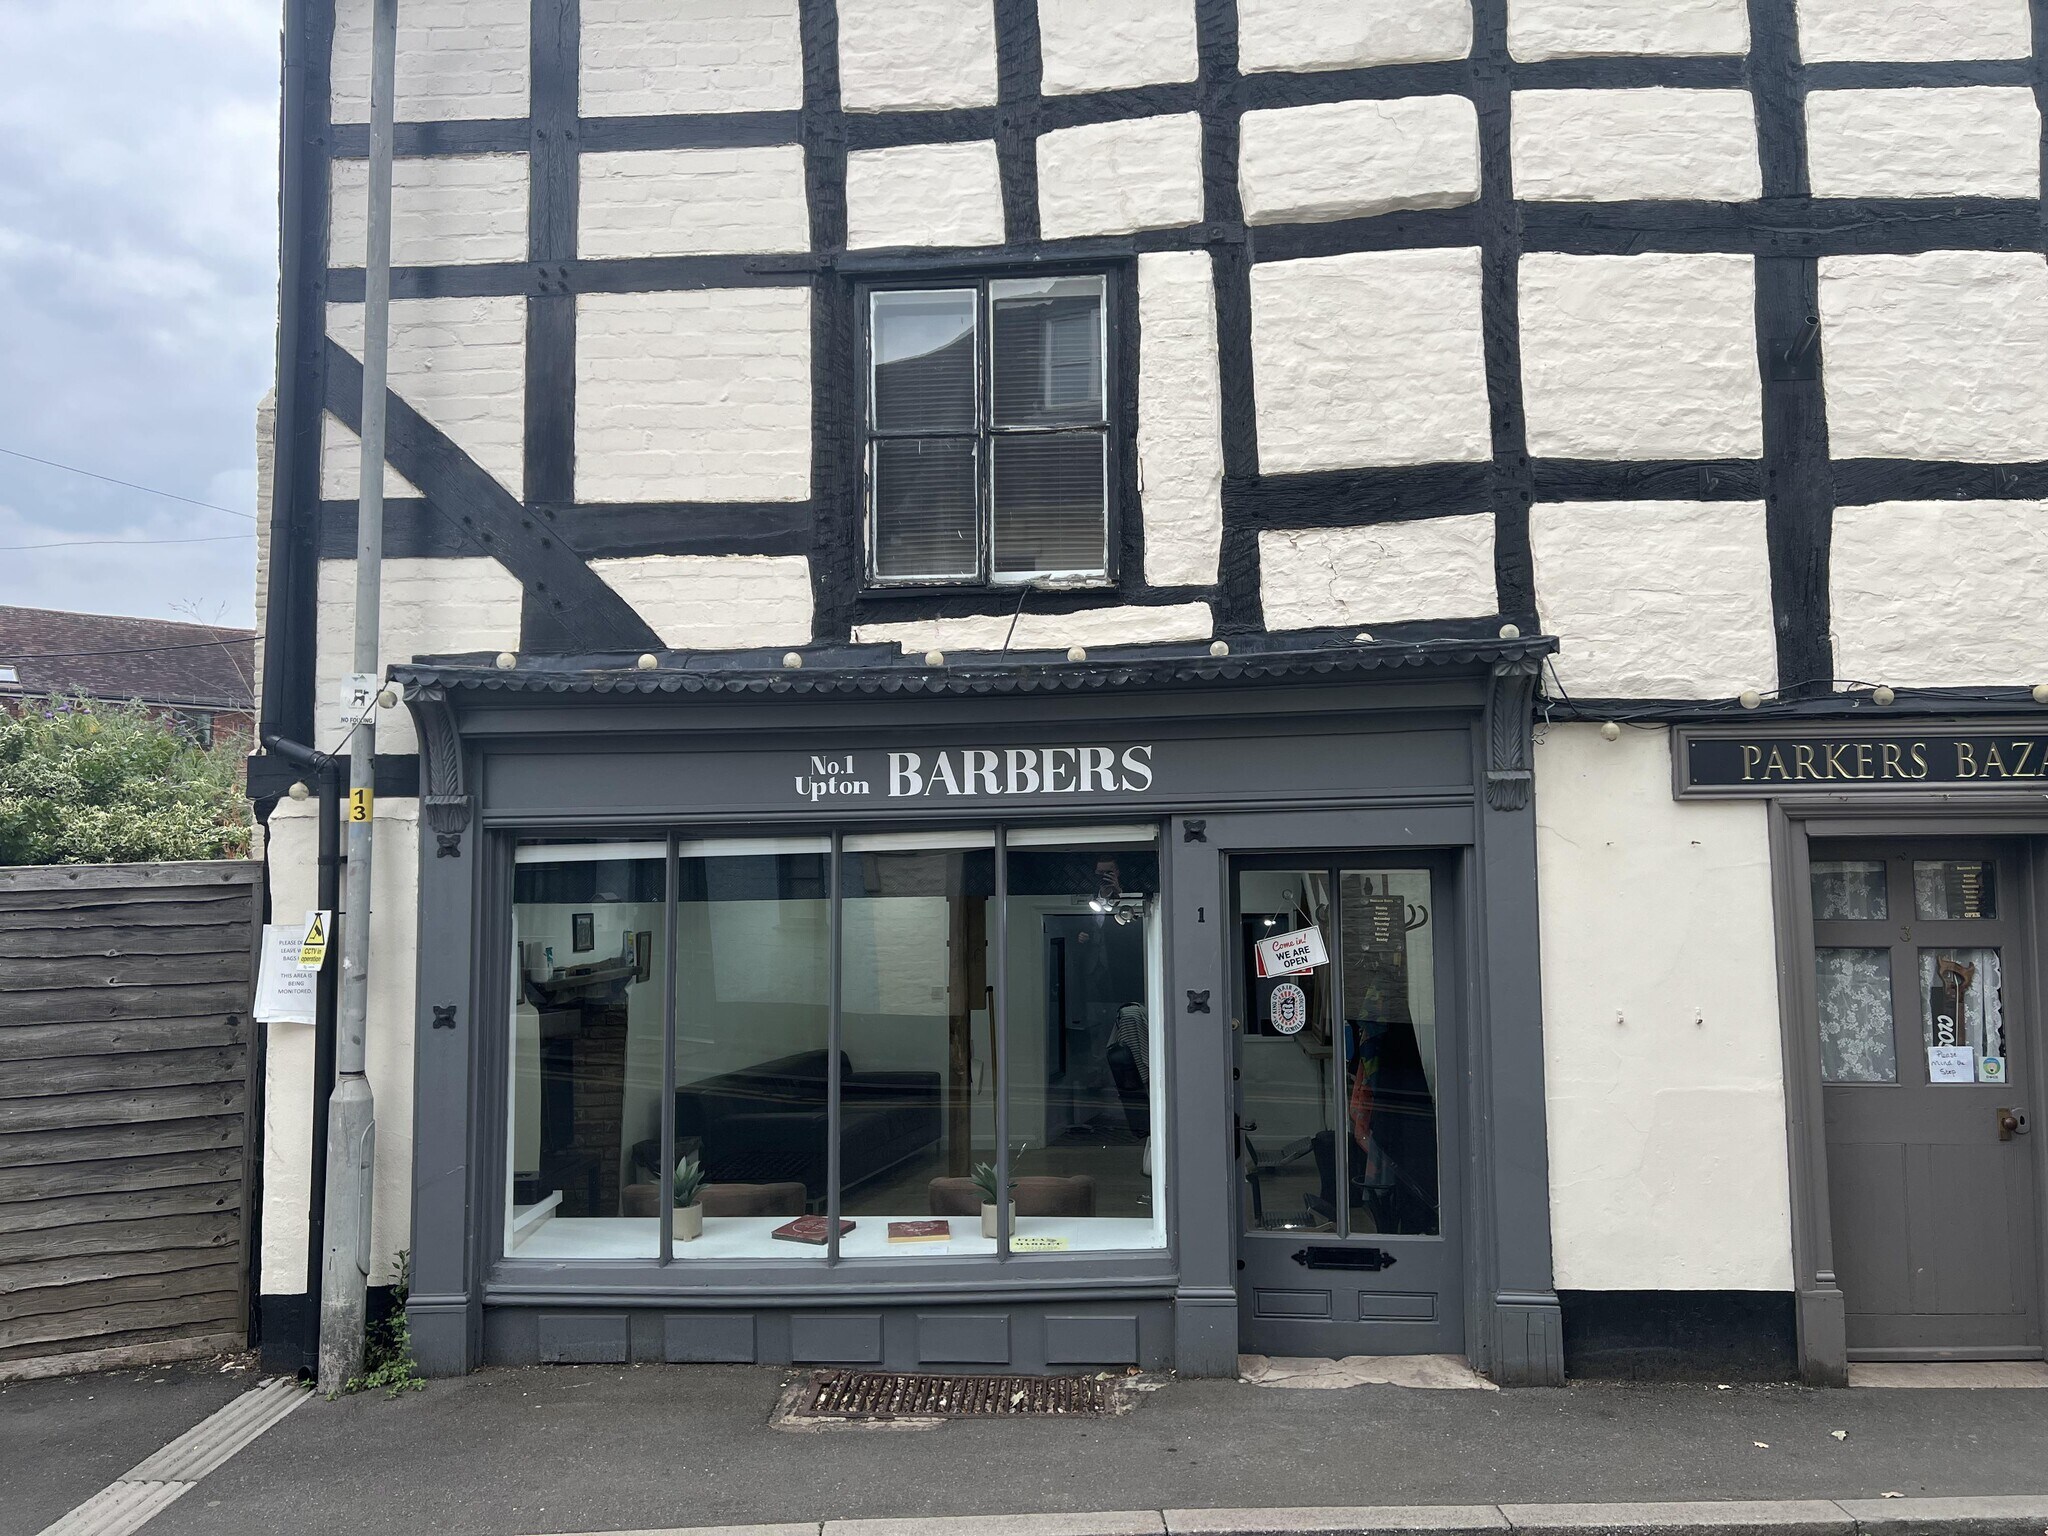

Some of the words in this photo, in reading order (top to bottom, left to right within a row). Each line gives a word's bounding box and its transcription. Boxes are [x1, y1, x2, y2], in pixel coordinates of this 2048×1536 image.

[810, 755, 855, 775] No.1
[887, 745, 1153, 797] BARBERS
[1740, 743, 1928, 780] PARKERS
[795, 776, 870, 801] Upton
[1198, 907, 1205, 923] 1
[1272, 940, 1295, 951] Come
[1296, 933, 1307, 946] in!
[1276, 951, 1291, 961] WE
[1293, 946, 1311, 957] ARE
[1284, 956, 1309, 968] OPEN
